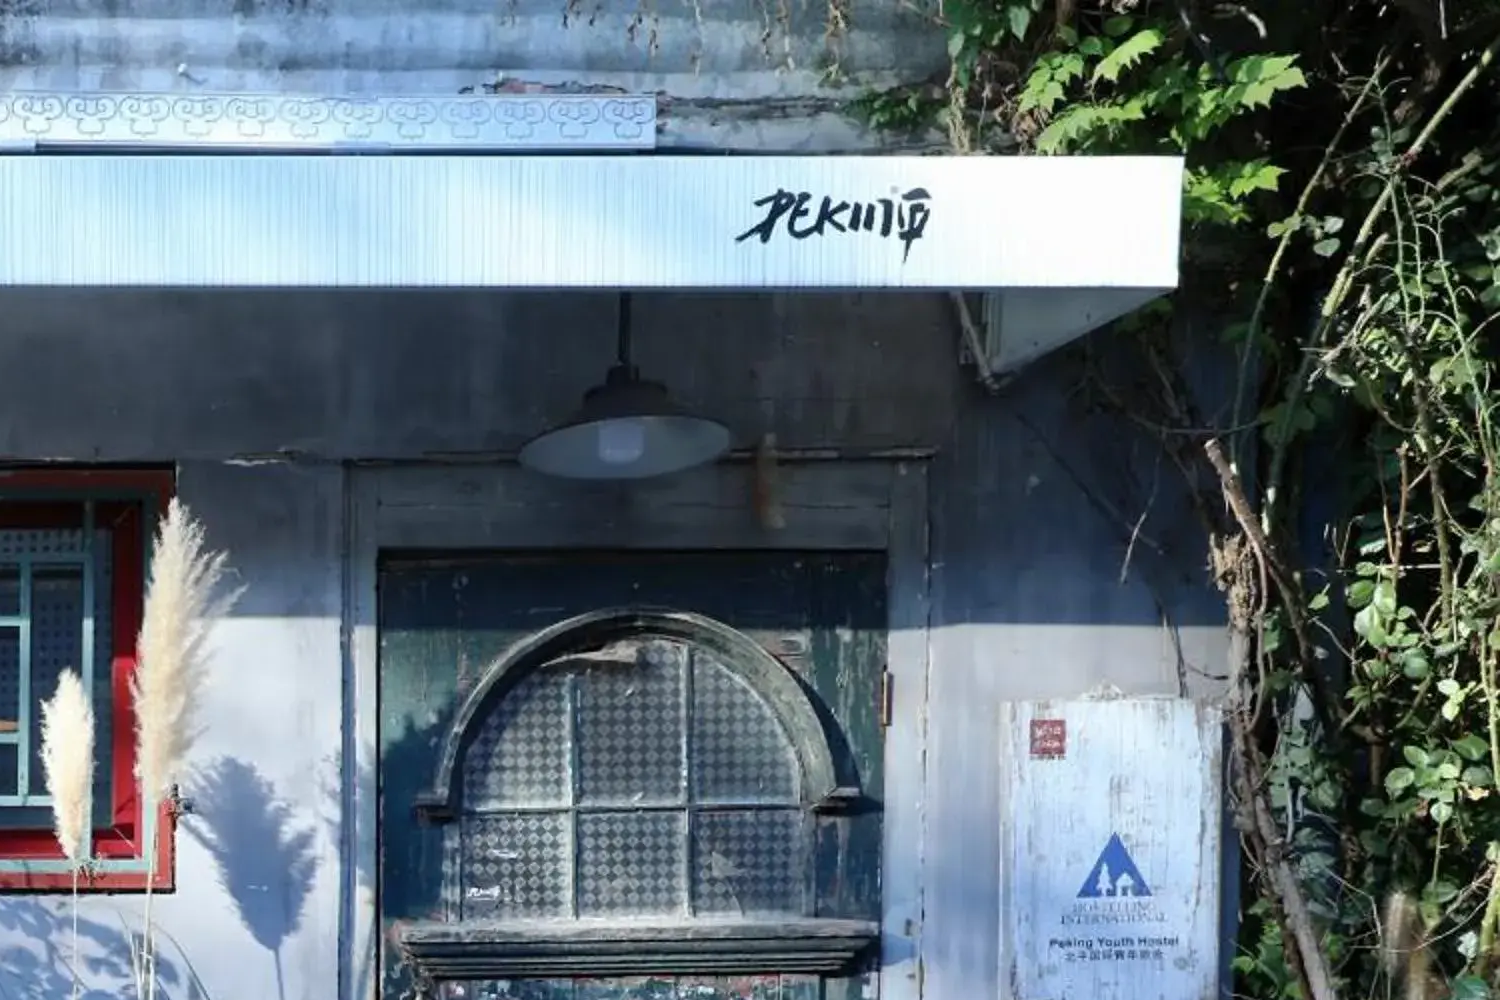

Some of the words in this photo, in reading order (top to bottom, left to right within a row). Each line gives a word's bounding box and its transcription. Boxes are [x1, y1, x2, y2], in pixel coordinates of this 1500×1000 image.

[1049, 937, 1093, 949] Peking
[1097, 936, 1135, 947] Youth
[1138, 935, 1179, 946] Hostel
